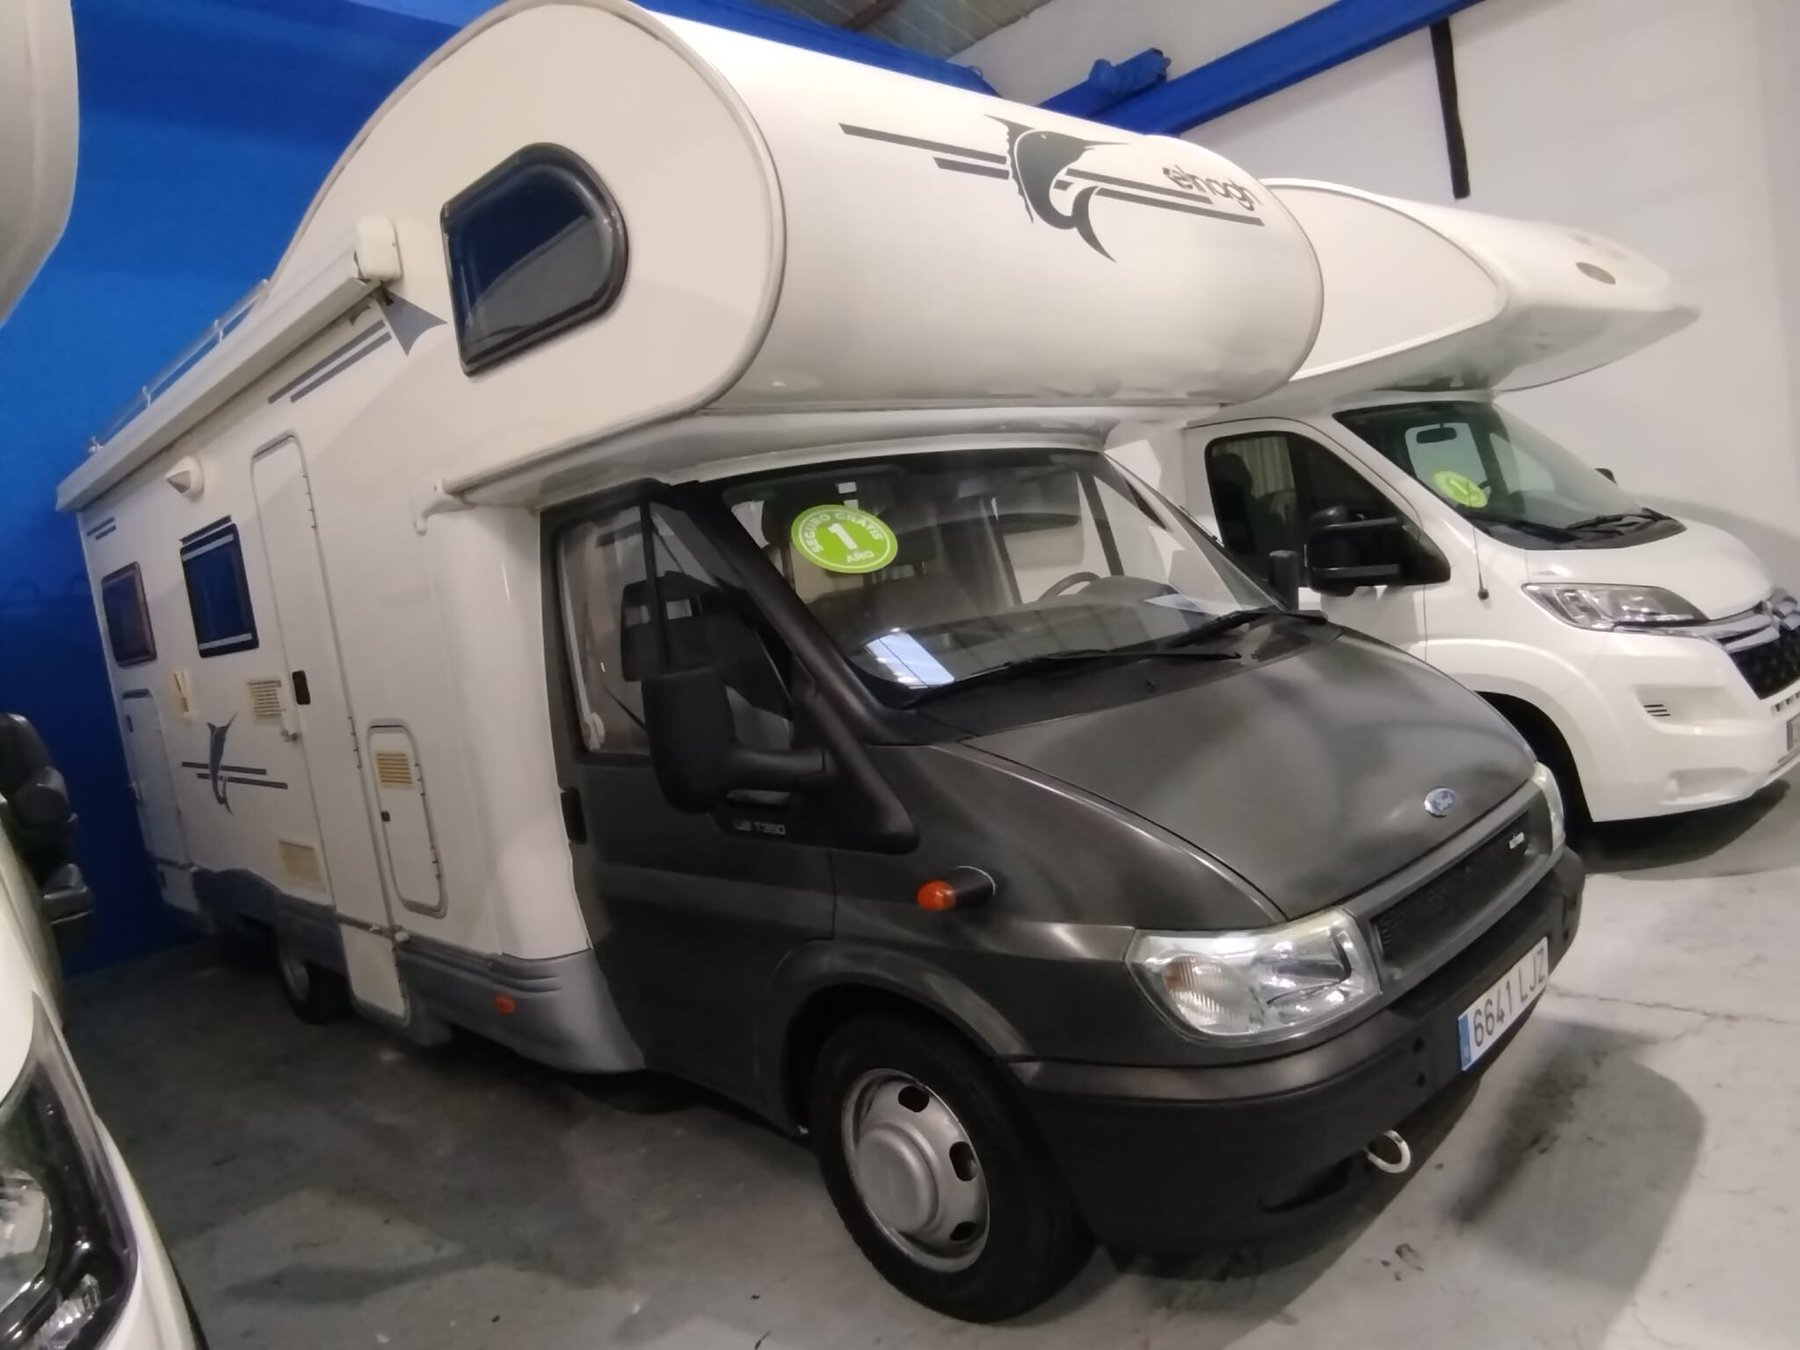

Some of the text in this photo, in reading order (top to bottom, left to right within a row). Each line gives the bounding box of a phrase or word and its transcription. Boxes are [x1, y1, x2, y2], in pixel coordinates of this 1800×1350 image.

[804, 513, 884, 553] SEGURO GRATIS
[828, 523, 858, 550] 1
[847, 550, 874, 564] AÑO
[1473, 946, 1546, 1048] 6641 LJZ
